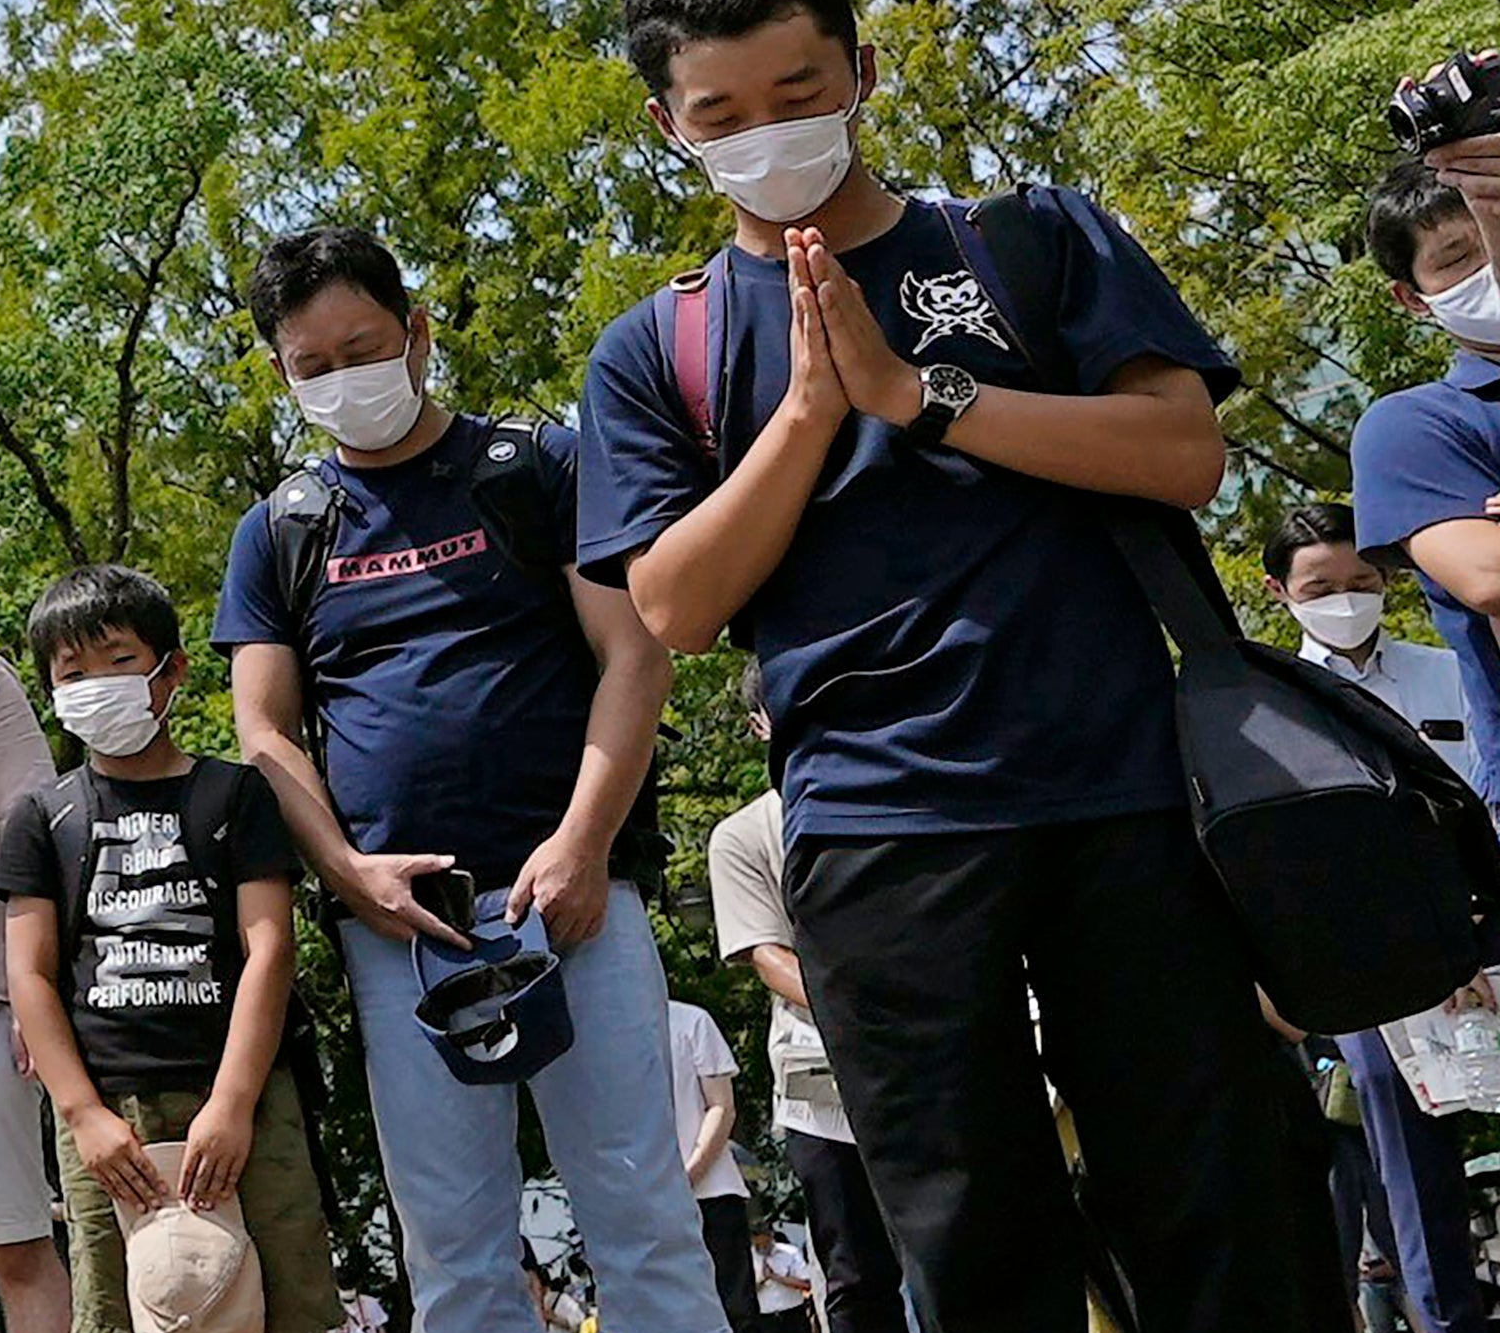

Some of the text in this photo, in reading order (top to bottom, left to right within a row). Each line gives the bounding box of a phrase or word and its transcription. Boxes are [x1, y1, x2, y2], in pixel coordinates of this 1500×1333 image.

[338, 535, 477, 578] MAMMUT
[117, 812, 175, 837] NEVER
[87, 879, 208, 915] DISCOURAGE
[106, 941, 208, 965] AUTHENTIC
[87, 981, 222, 1008] PERFORMANCE
